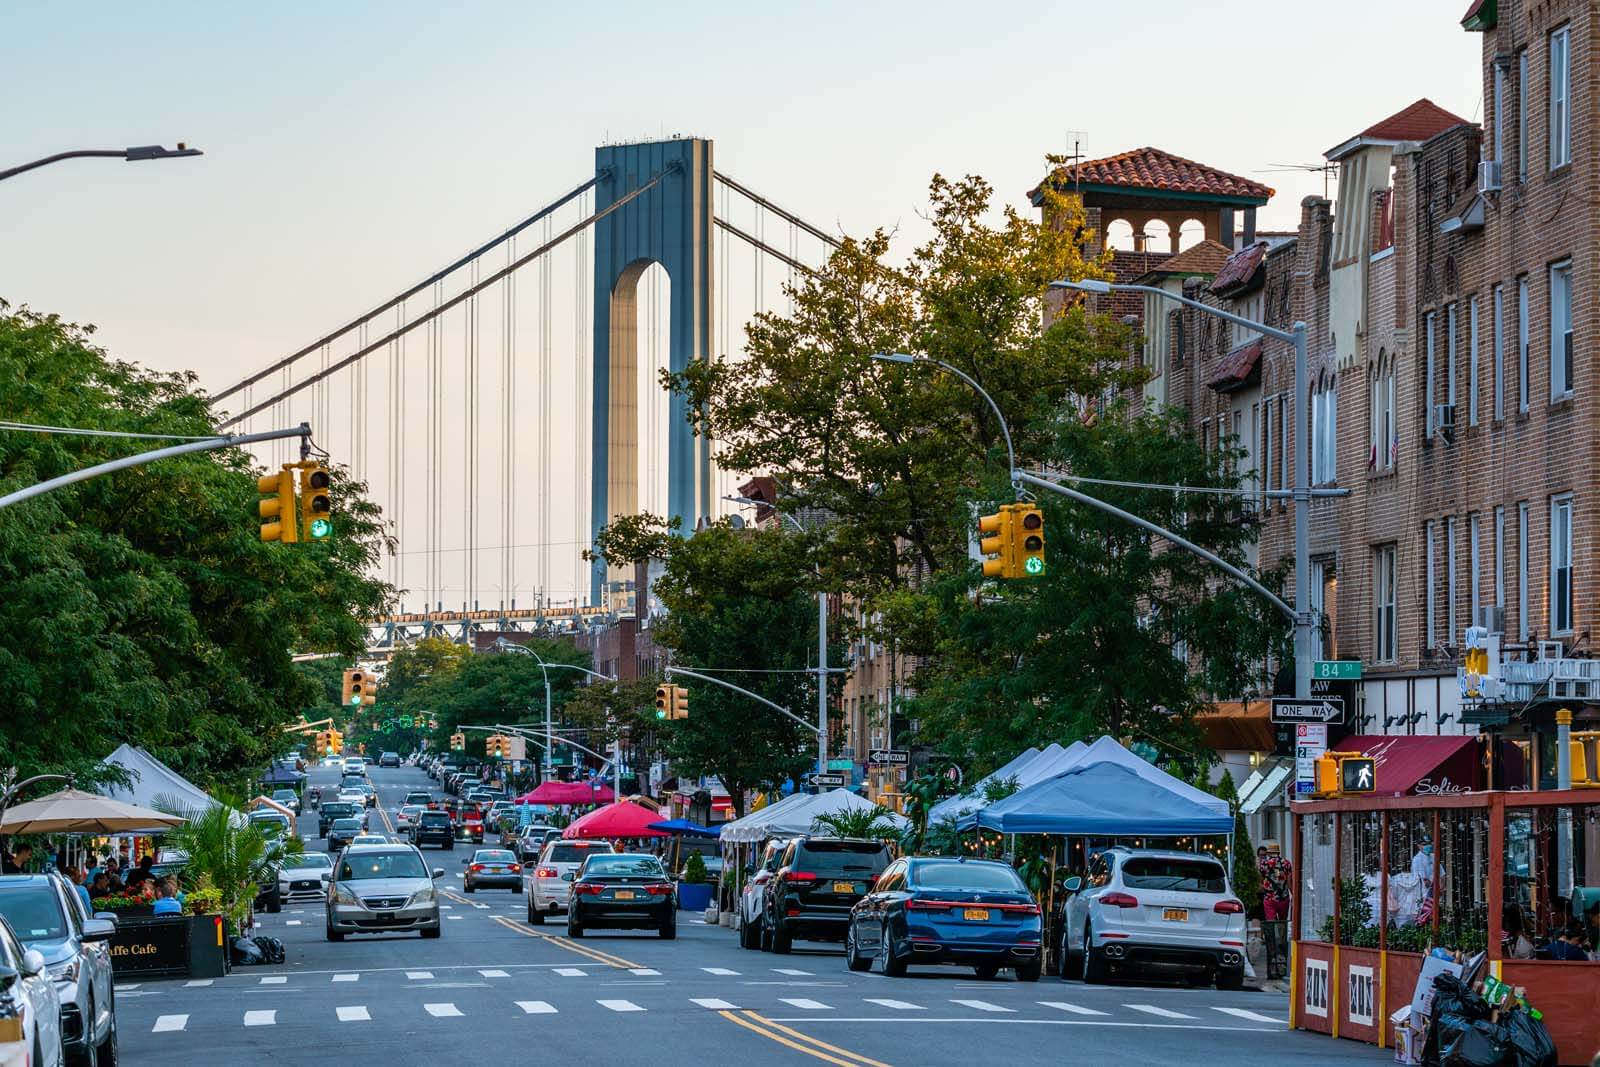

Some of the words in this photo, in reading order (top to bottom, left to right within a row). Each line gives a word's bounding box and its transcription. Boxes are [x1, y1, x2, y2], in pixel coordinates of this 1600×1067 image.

[1321, 663, 1340, 677] 84
[1310, 680, 1330, 691] AW
[1281, 705, 1302, 715] ONE
[1311, 706, 1333, 716] WAY
[1415, 776, 1471, 796] Sofia
